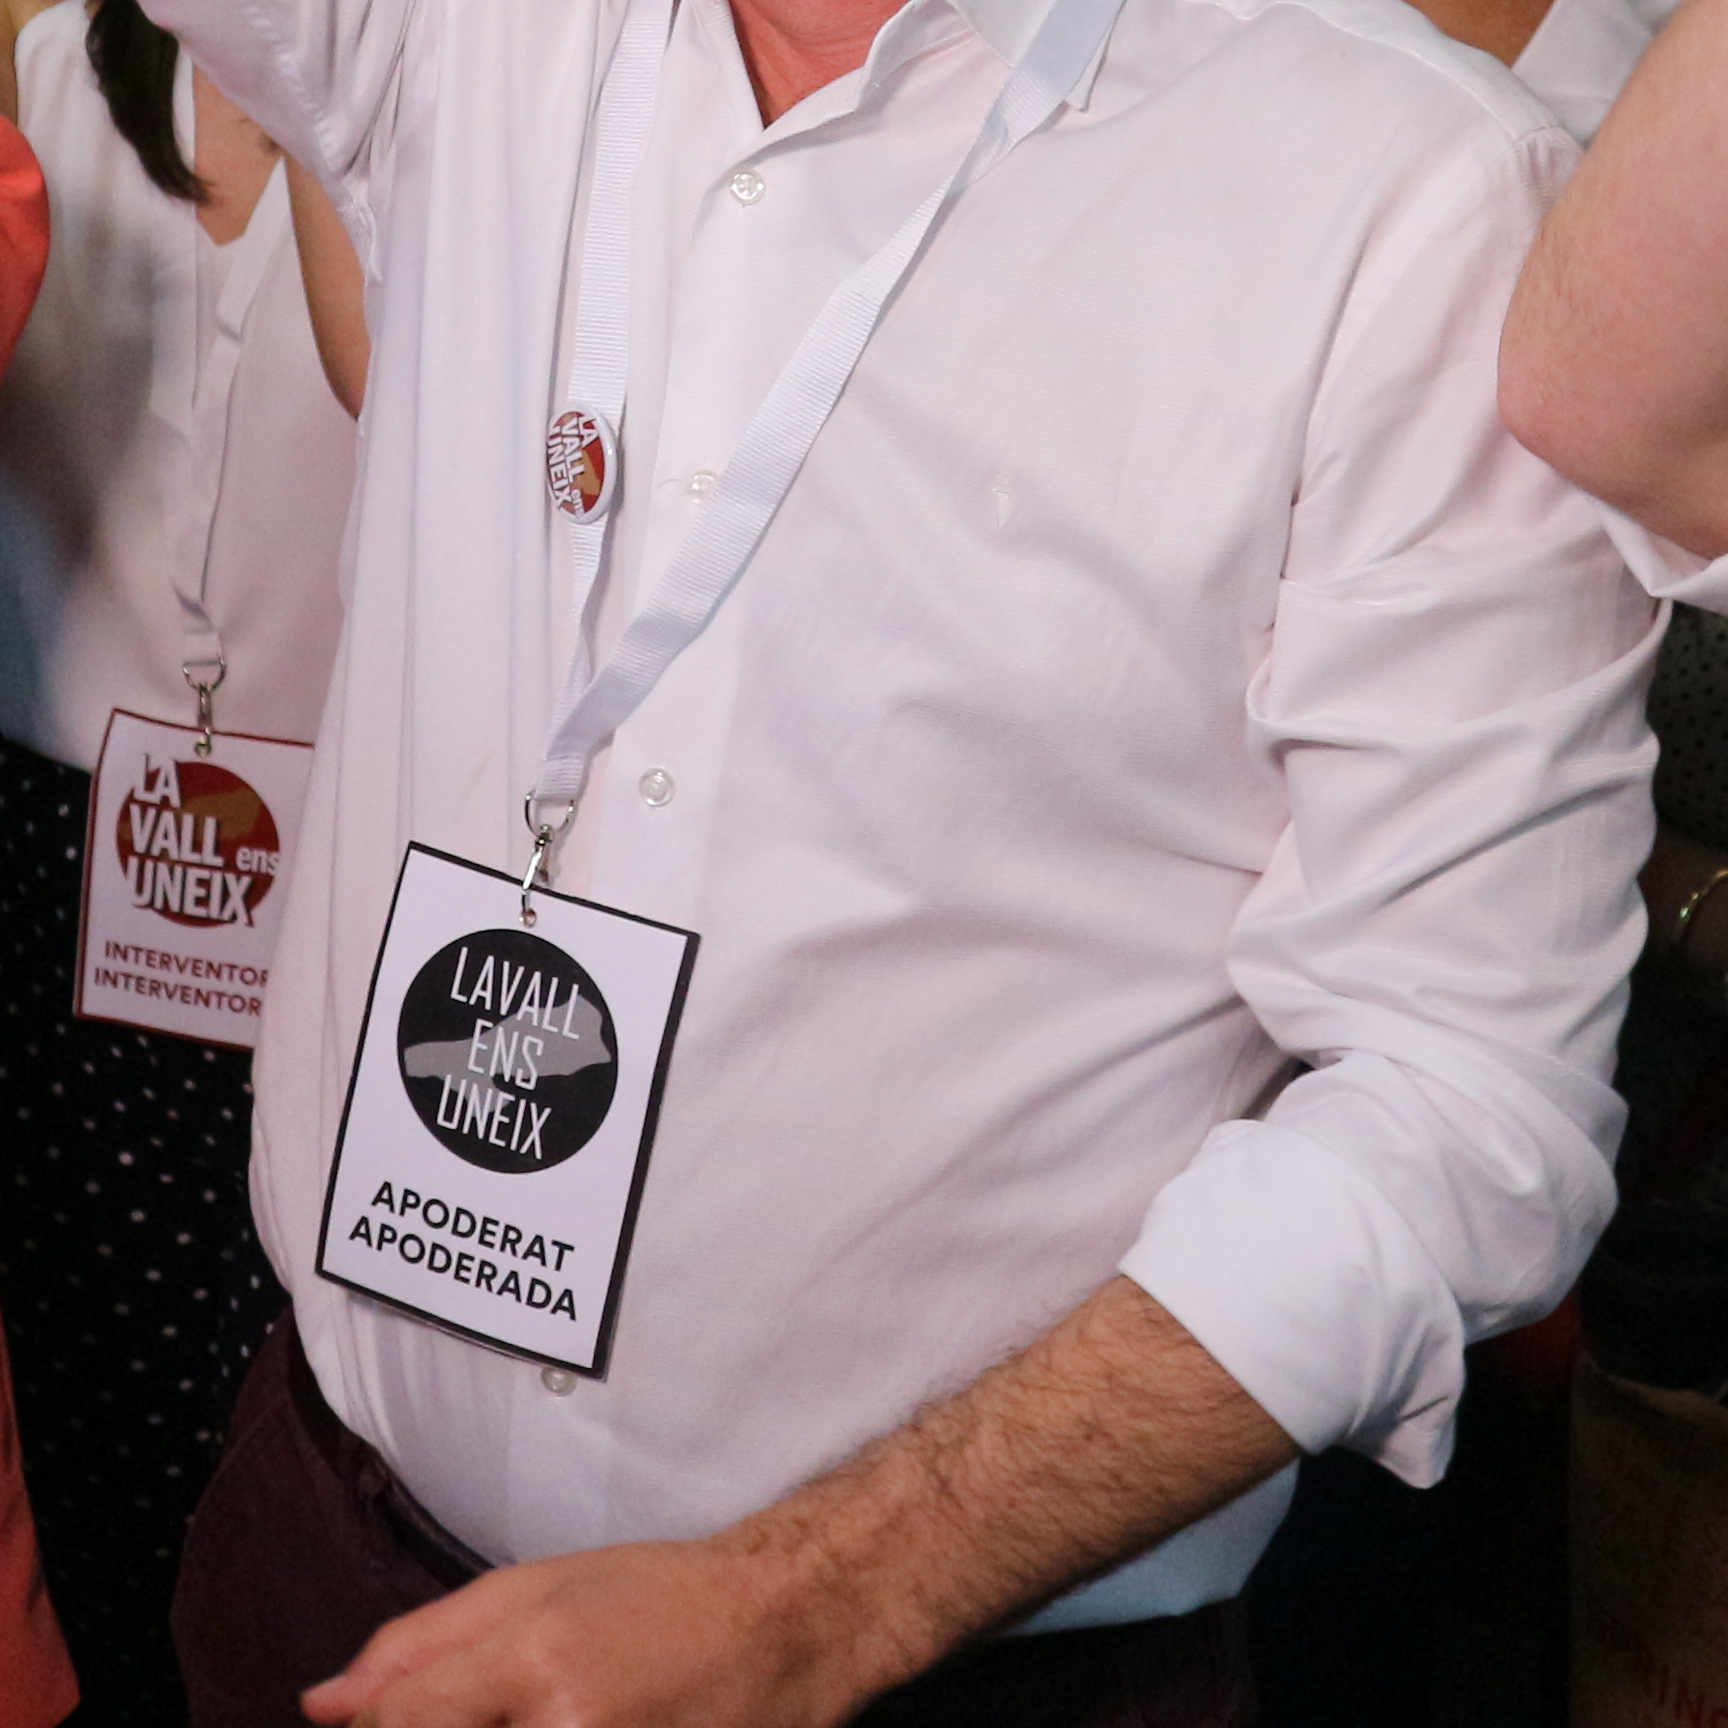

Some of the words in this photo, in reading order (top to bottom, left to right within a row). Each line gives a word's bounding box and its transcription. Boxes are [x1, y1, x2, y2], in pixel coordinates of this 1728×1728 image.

[561, 417, 586, 483] VALL
[133, 753, 182, 808] LA
[128, 803, 225, 868] VALL
[235, 843, 280, 875] ens
[126, 854, 255, 927] UNEIX
[94, 967, 263, 1017] INTERVENTOR
[467, 1020, 544, 1092] ENS
[436, 1073, 552, 1161] UNEIX
[370, 1180, 576, 1274] APODERAT
[348, 1214, 578, 1322] APODERADA
